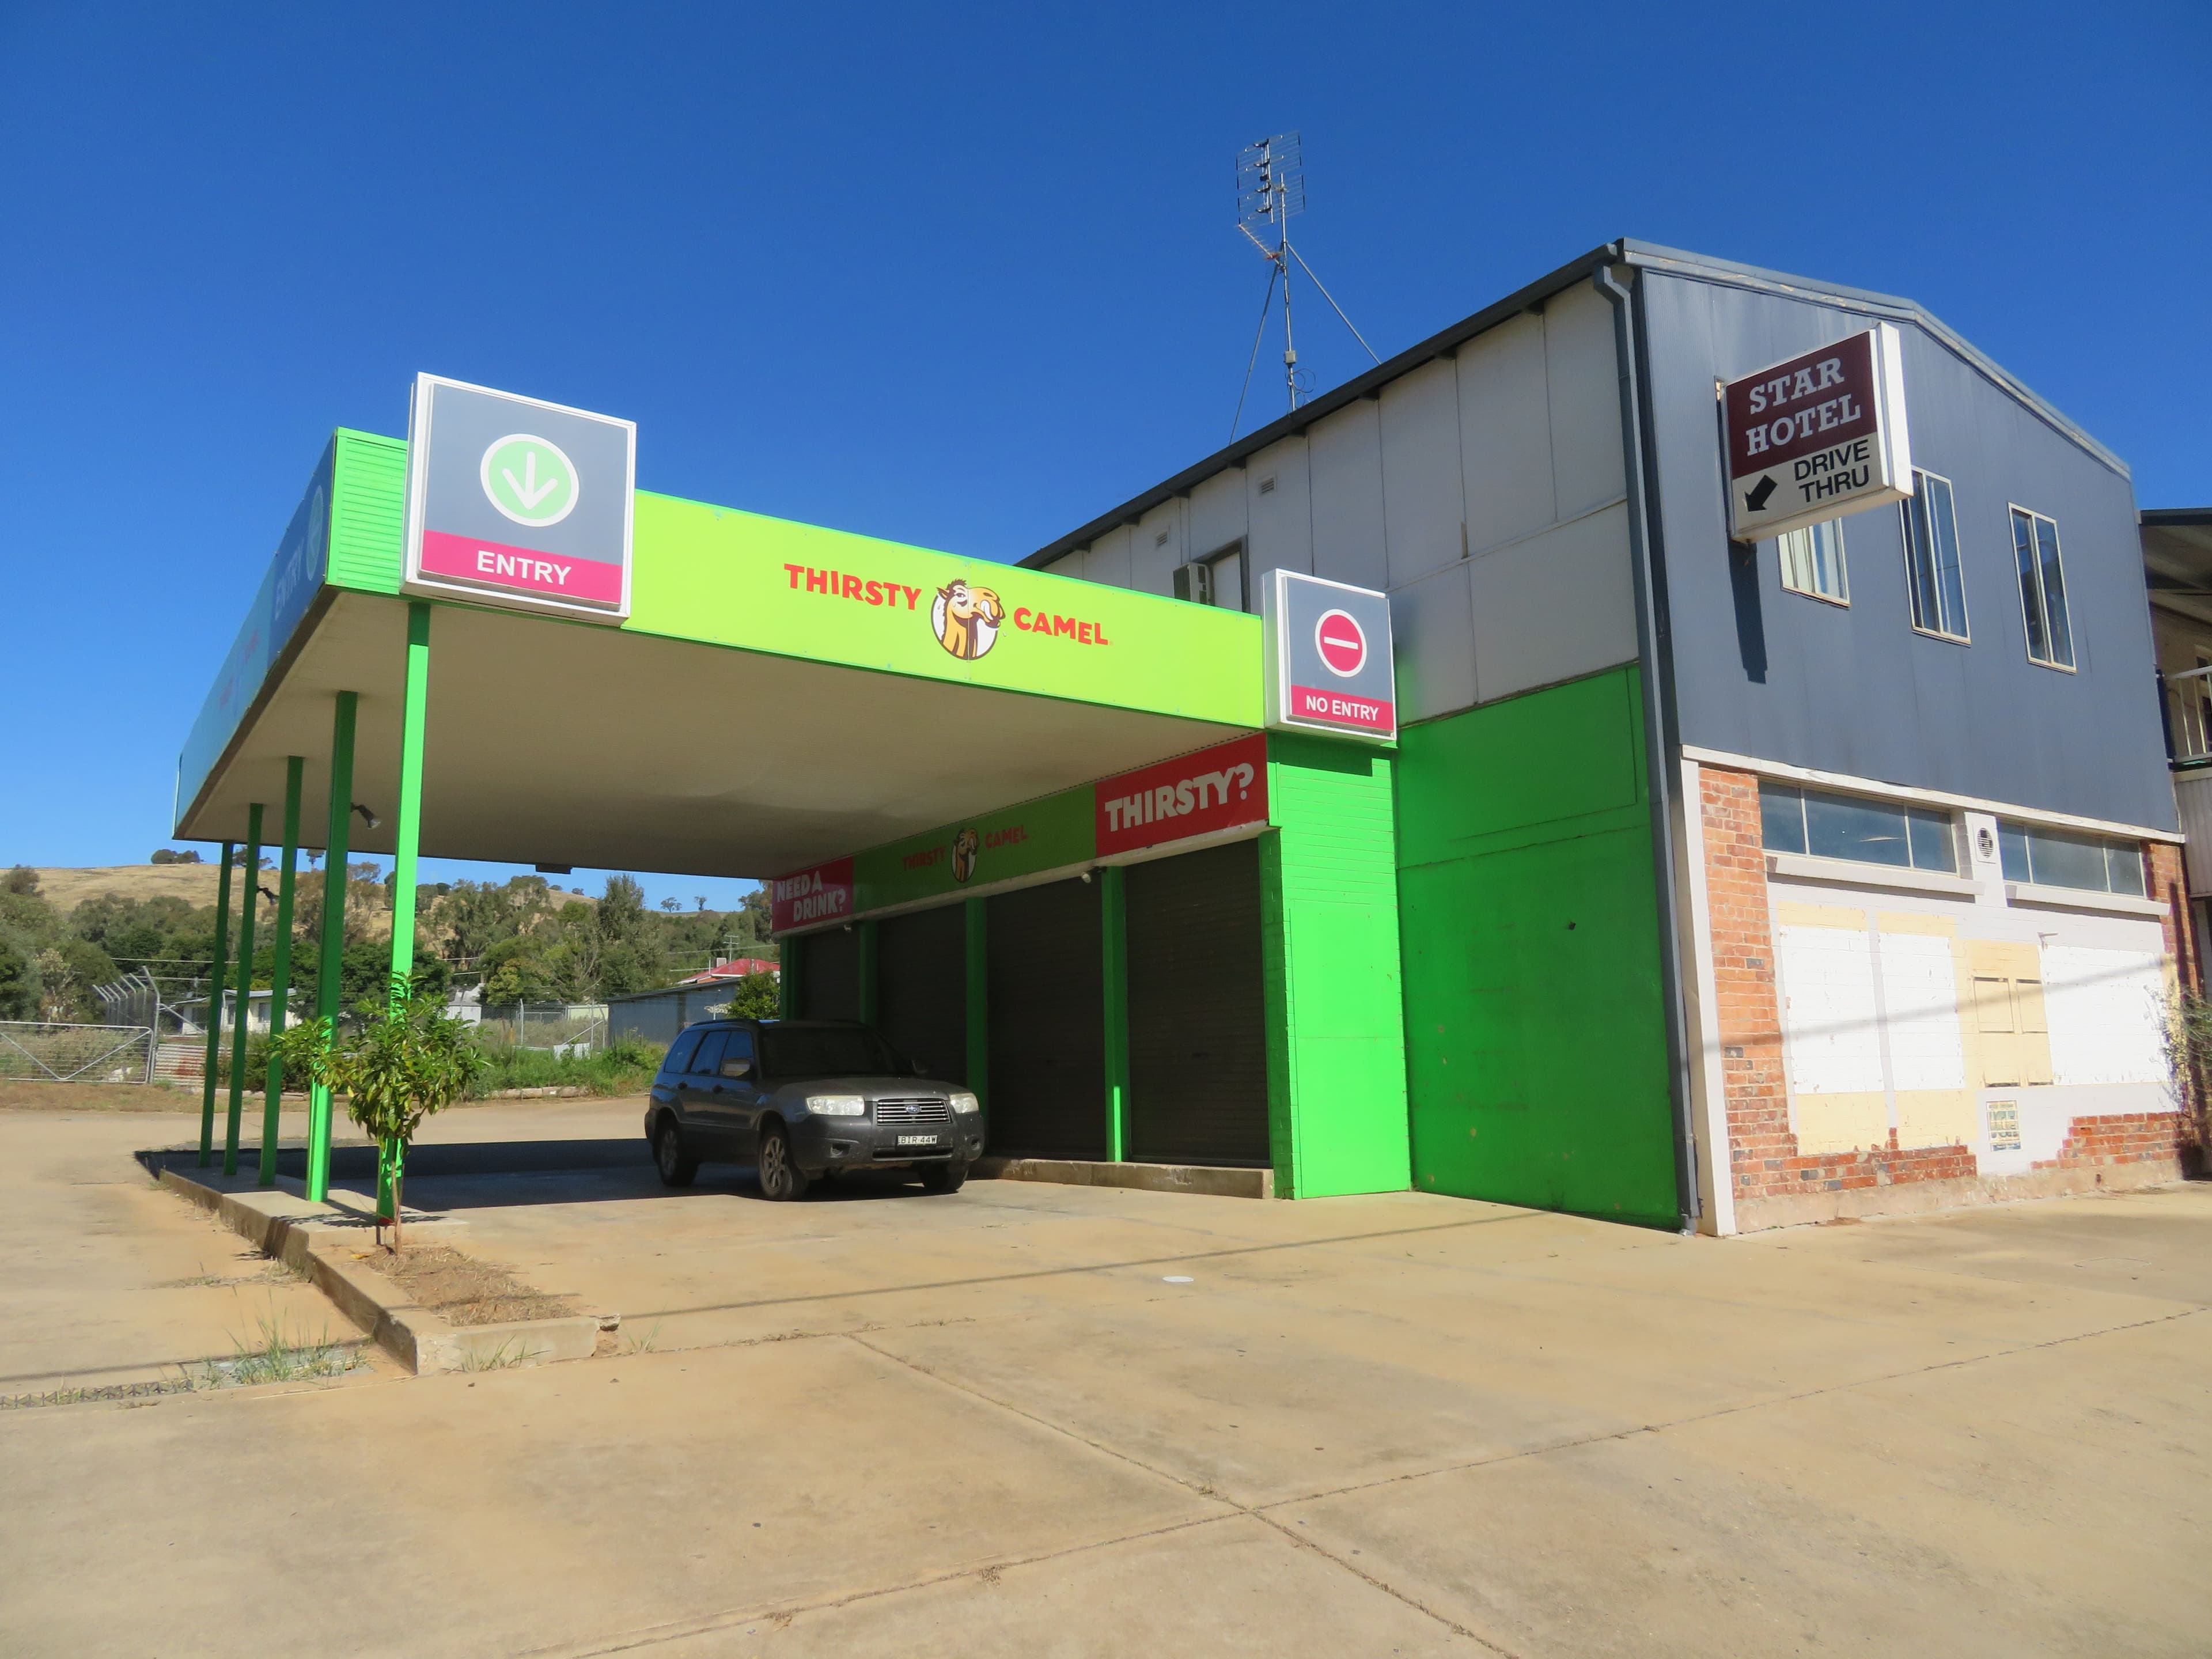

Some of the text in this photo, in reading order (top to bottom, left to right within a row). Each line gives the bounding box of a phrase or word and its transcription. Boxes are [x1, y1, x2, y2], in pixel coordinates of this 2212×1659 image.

[1749, 357, 1844, 415] STAR
[1745, 393, 1861, 457] HOTEL
[1794, 439, 1870, 482] DRIVE
[1798, 464, 1870, 503] THRU
[477, 550, 572, 586] ENTRY
[784, 563, 1108, 646] THIRSTY CAMEL
[1306, 695, 1379, 721] NO ENTRY
[1105, 763, 1255, 832] THIRSTY?
[902, 825, 1028, 872] THIRSTY CAMEL
[777, 870, 823, 903] NEED A
[793, 888, 846, 922] DRINK?
